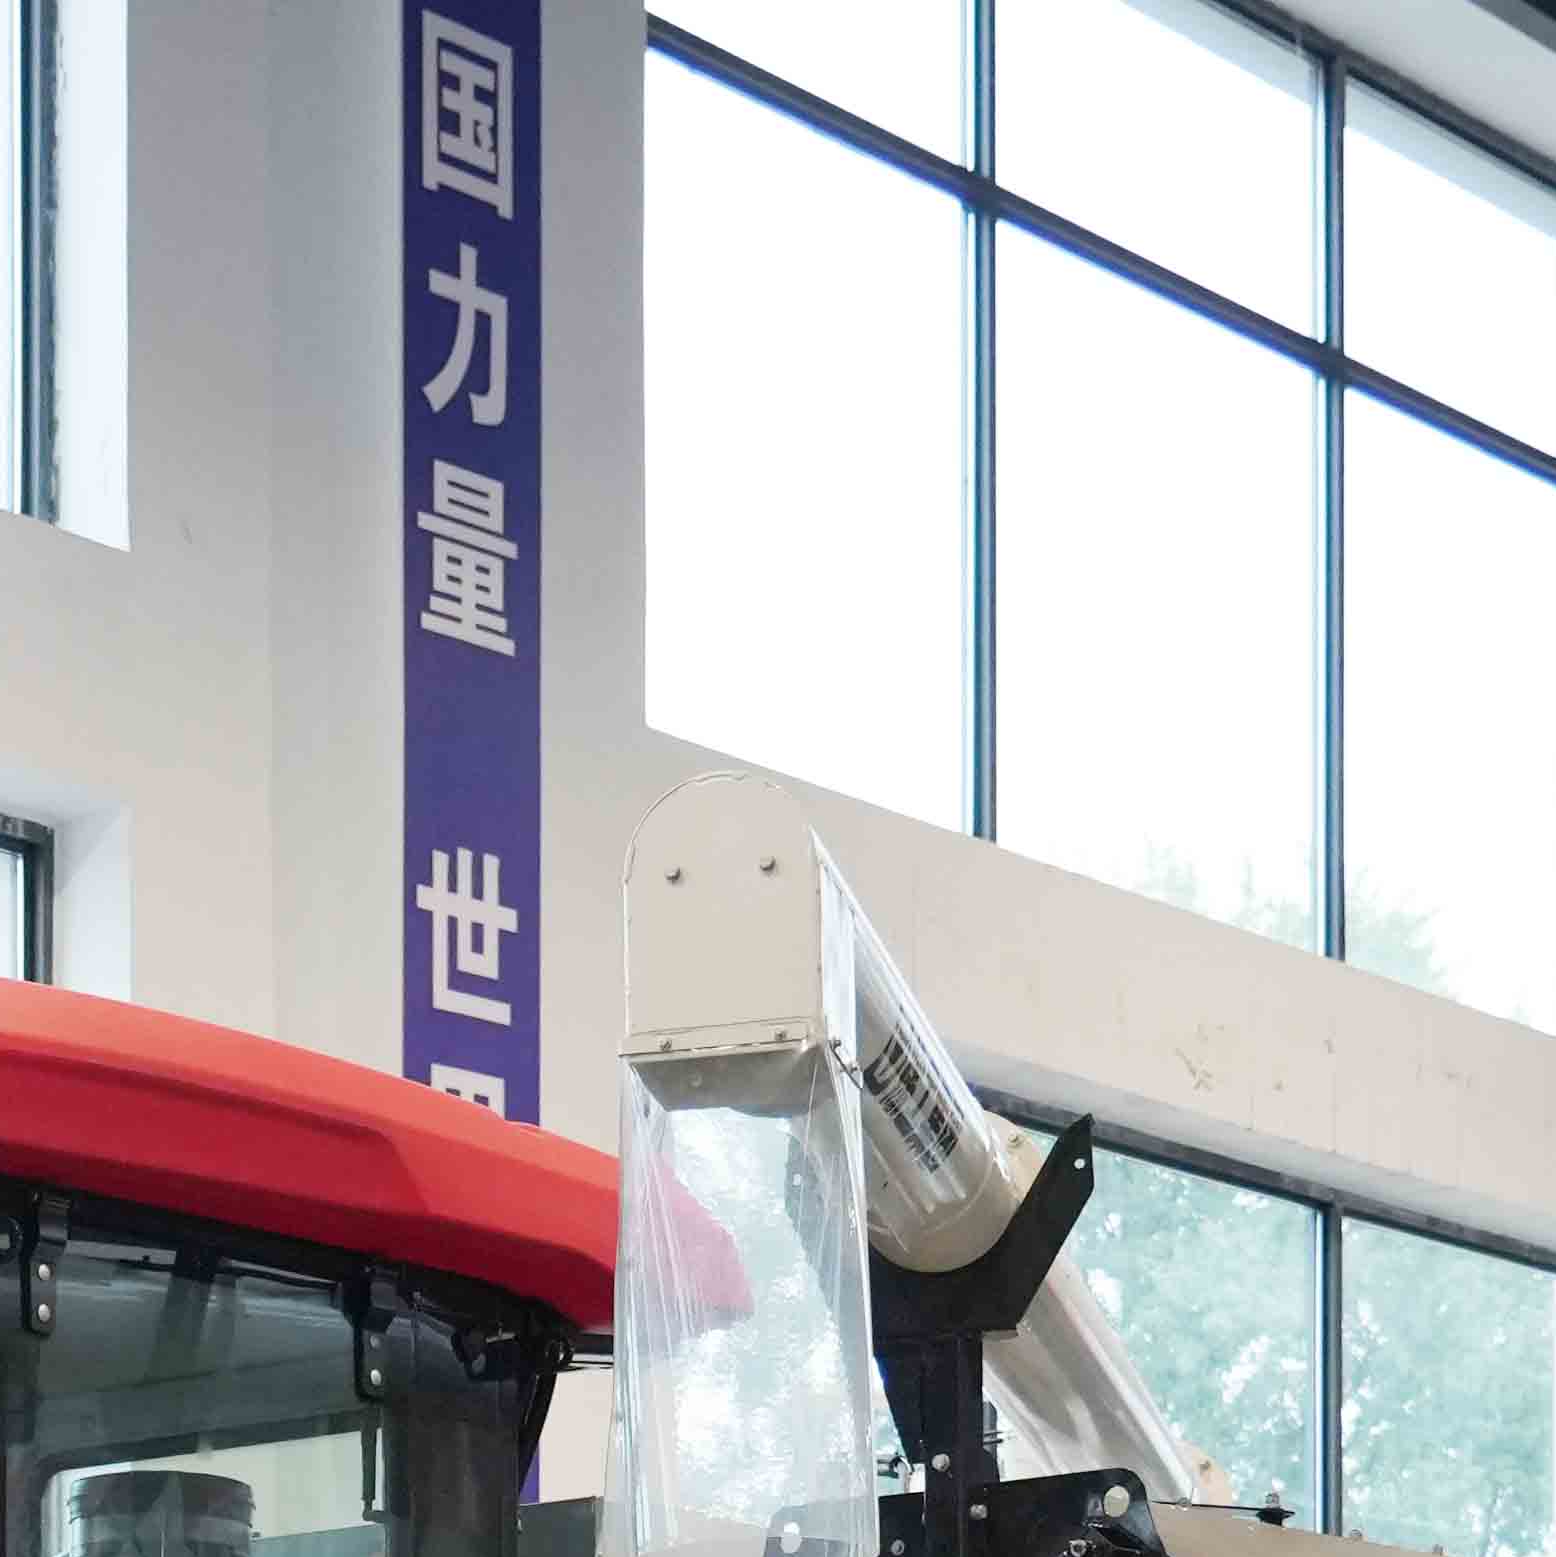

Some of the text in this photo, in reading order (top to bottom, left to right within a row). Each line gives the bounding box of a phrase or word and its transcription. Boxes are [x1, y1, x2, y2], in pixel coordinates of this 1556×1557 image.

[416, 9, 520, 1120] 国力量 世
